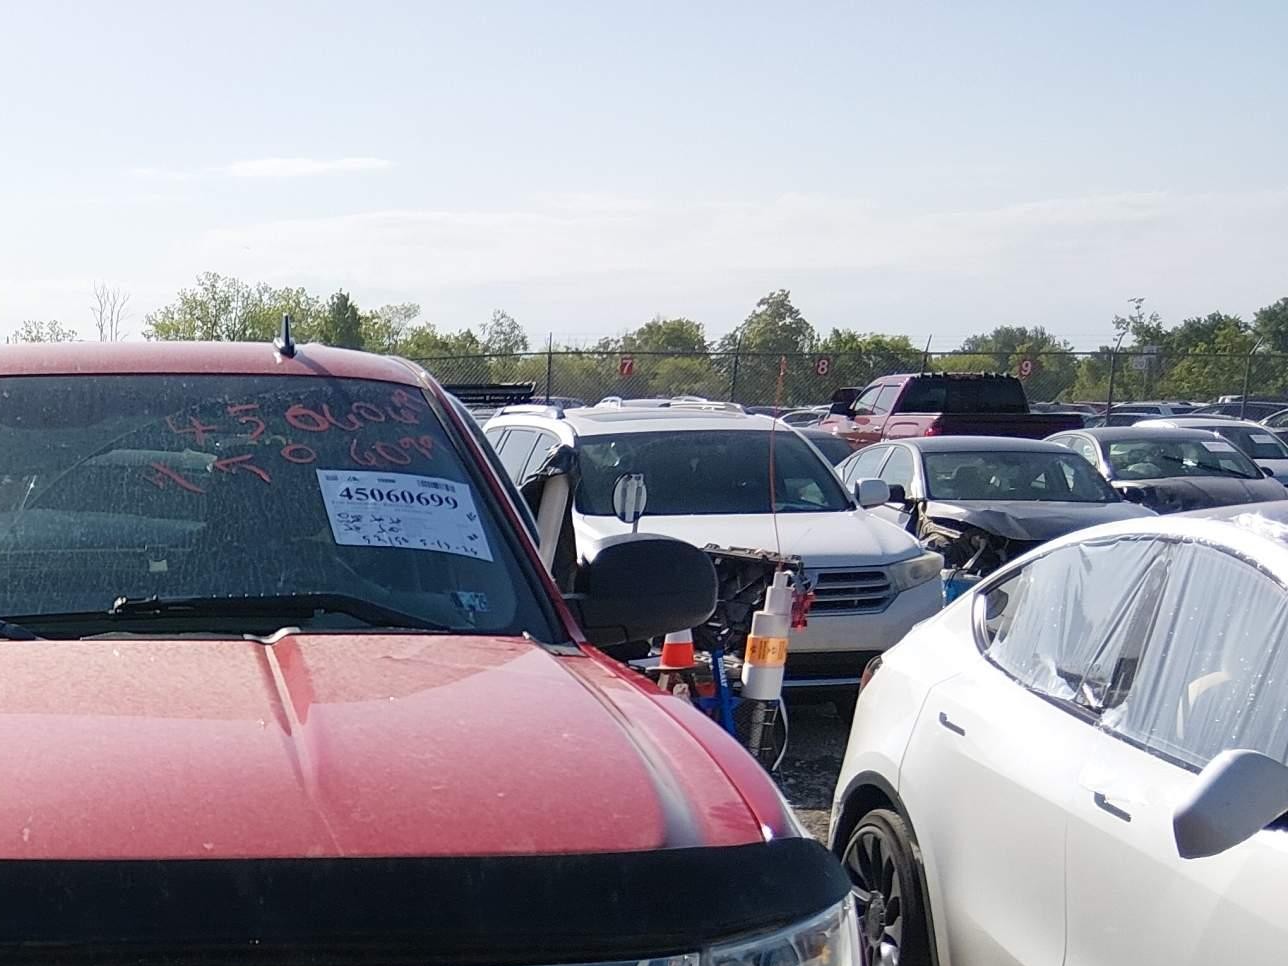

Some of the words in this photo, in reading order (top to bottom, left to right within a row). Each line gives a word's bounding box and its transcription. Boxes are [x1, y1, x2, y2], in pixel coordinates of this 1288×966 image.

[622, 359, 632, 374] 7
[817, 359, 829, 375] 8
[1021, 360, 1032, 375] 9
[339, 486, 458, 510] 45060699
